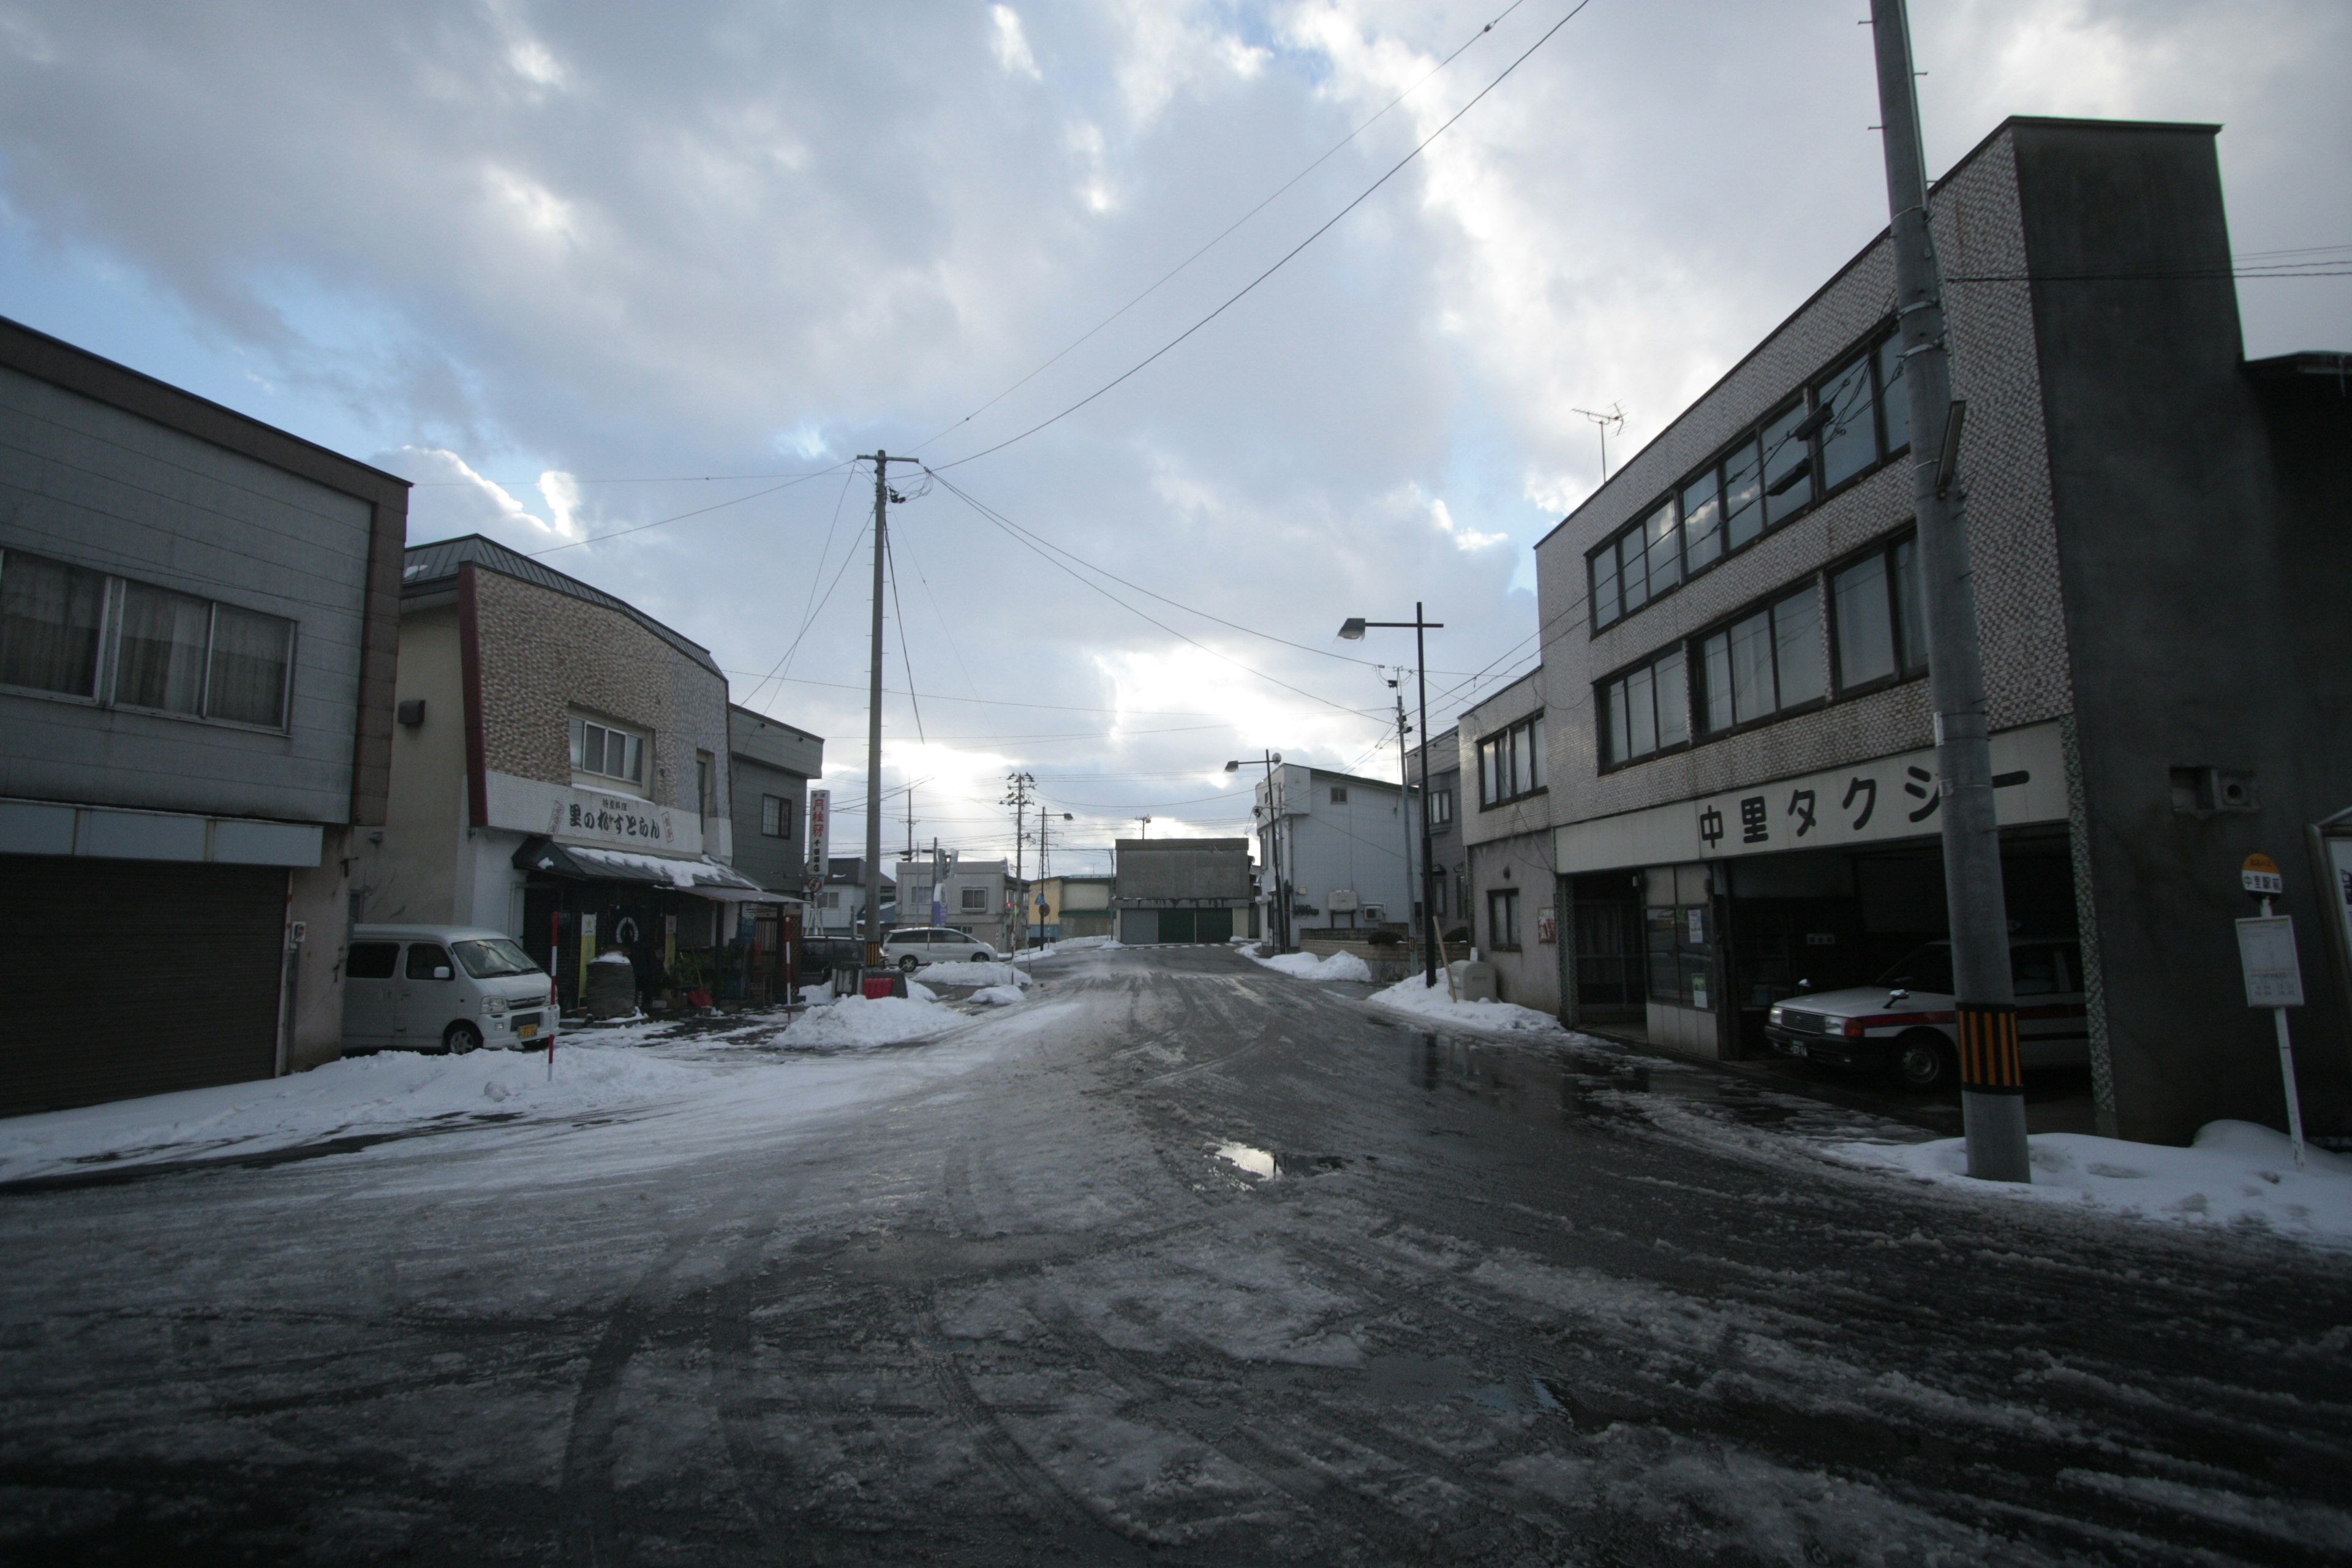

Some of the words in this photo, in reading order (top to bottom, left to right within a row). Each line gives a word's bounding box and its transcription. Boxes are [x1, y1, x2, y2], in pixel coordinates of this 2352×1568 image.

[570, 804, 660, 839] 里のれすとらん
[812, 799, 824, 837] 月桂冠
[1700, 766, 2030, 849] 中里タクシー
